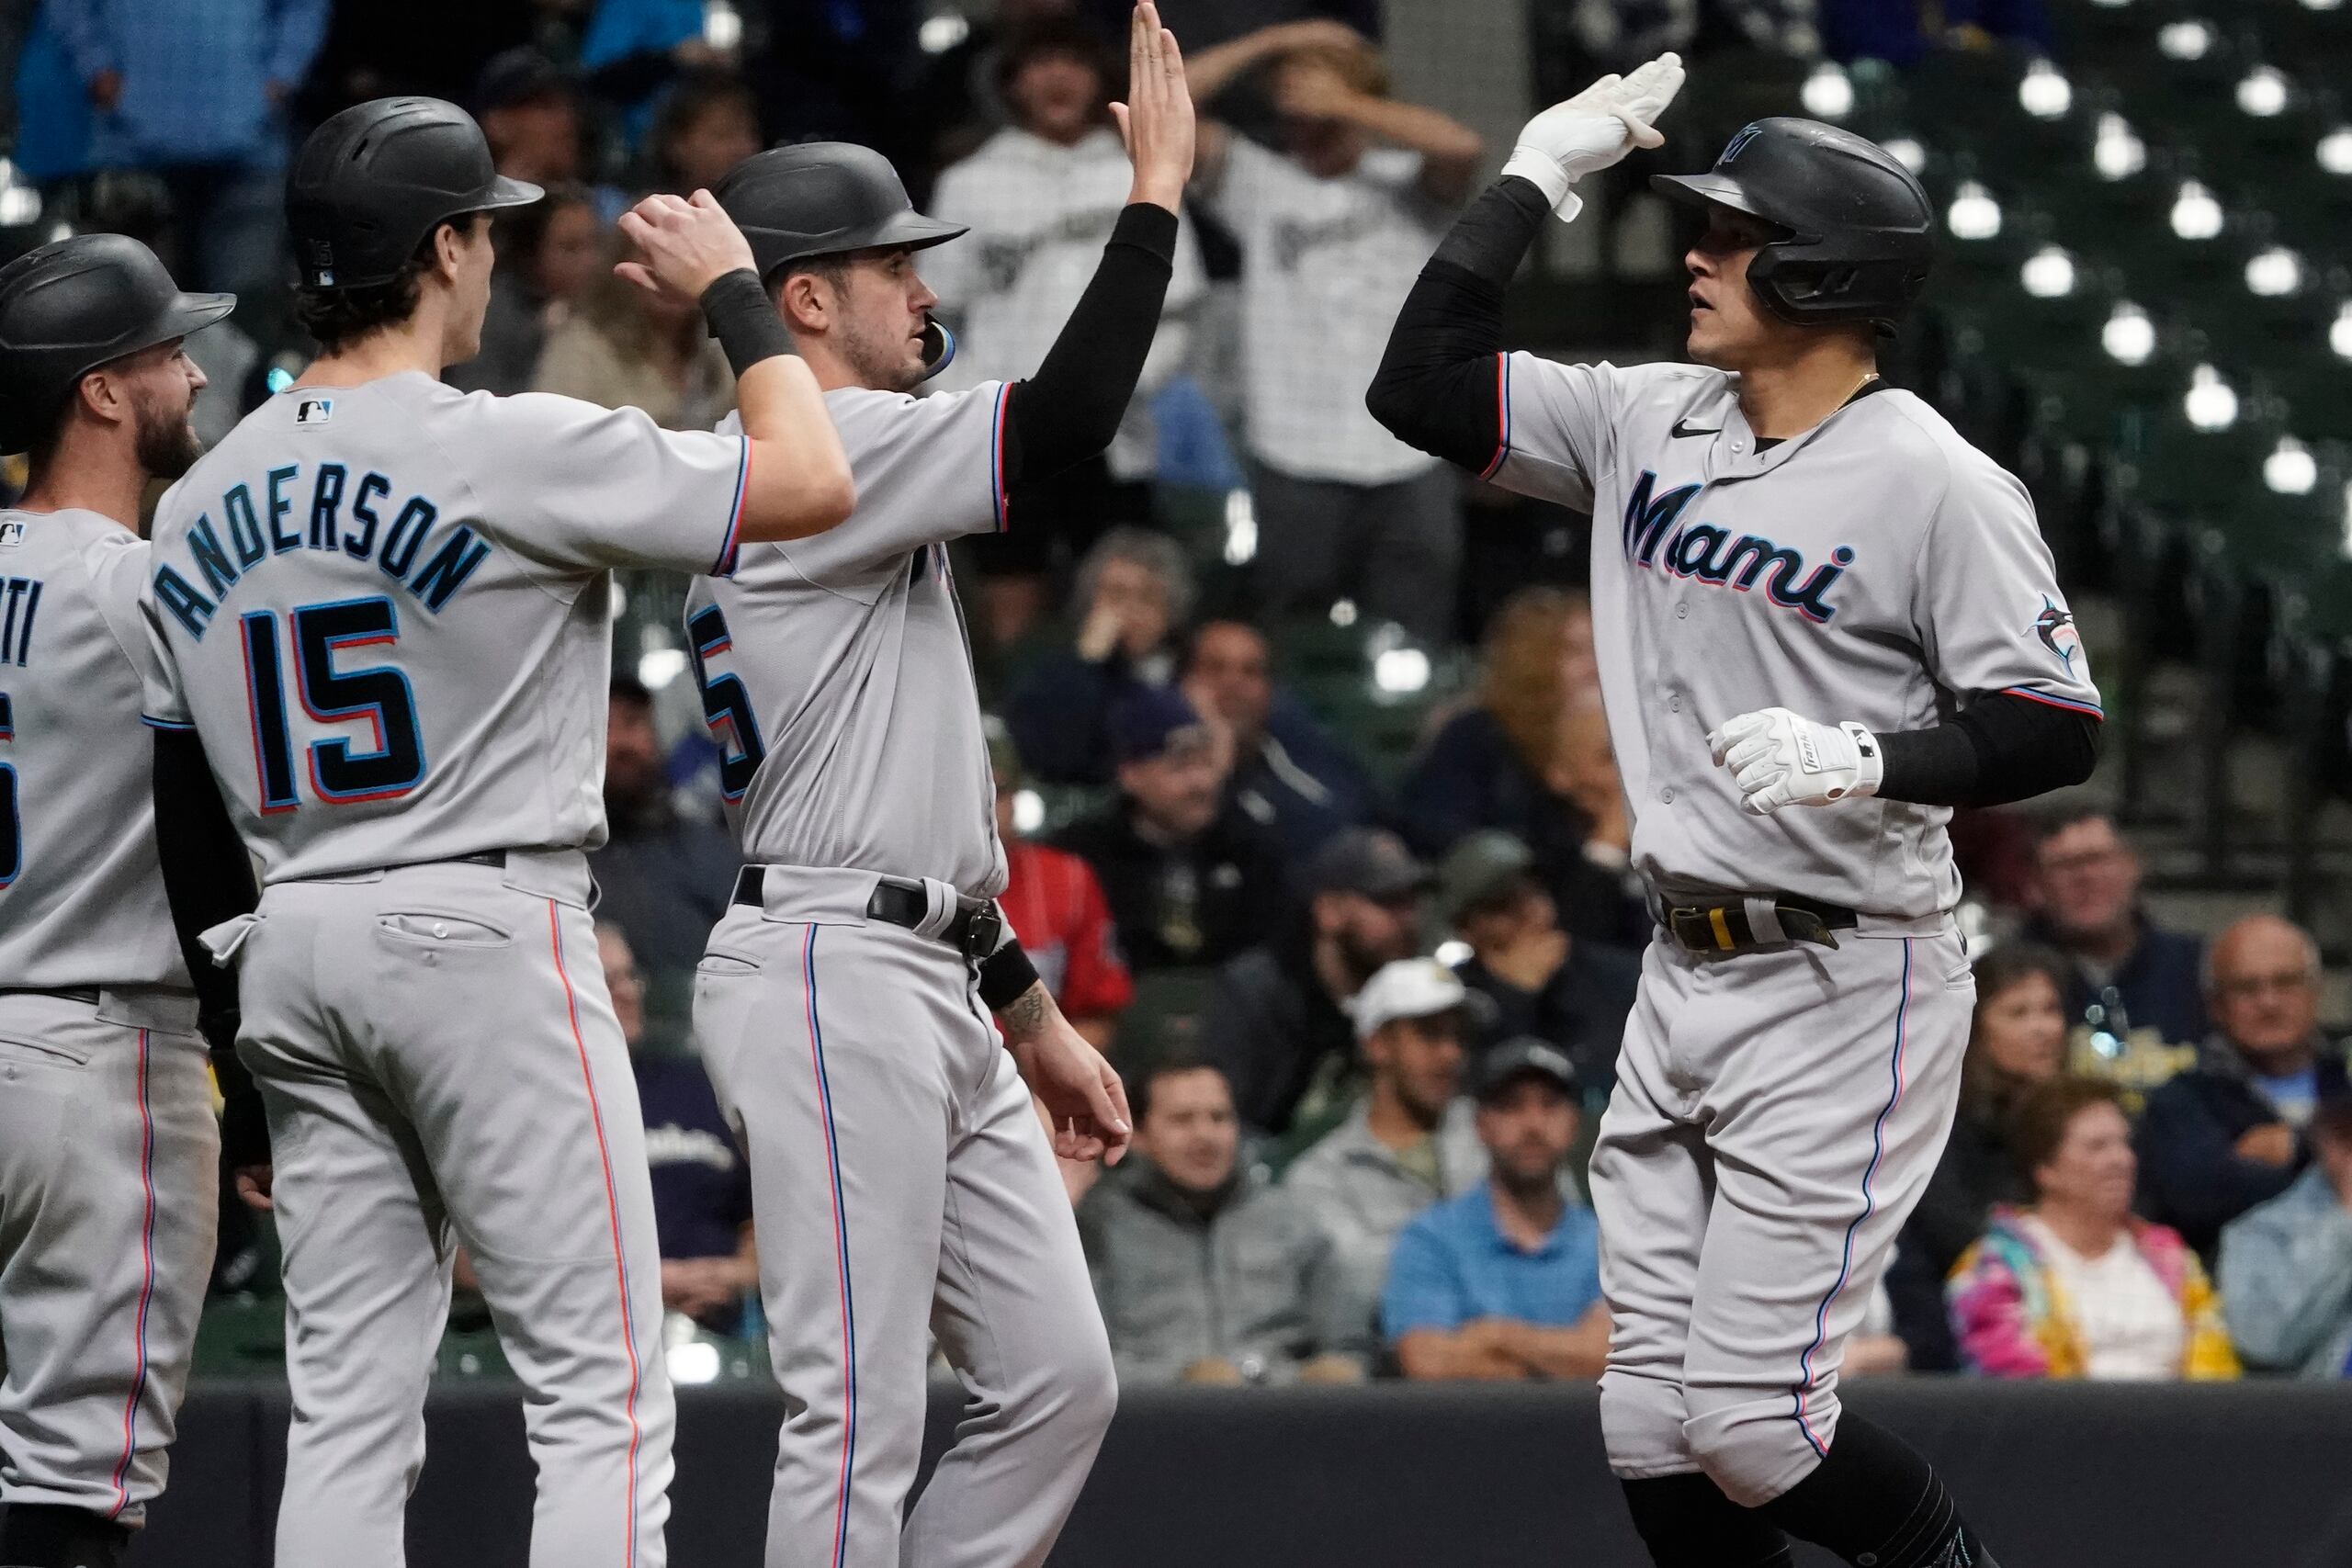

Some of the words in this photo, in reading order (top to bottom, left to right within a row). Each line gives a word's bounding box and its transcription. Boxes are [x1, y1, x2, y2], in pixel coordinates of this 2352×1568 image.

[0, 575, 44, 668] TI
[153, 462, 492, 642] ANDERSON
[239, 594, 428, 817] 15
